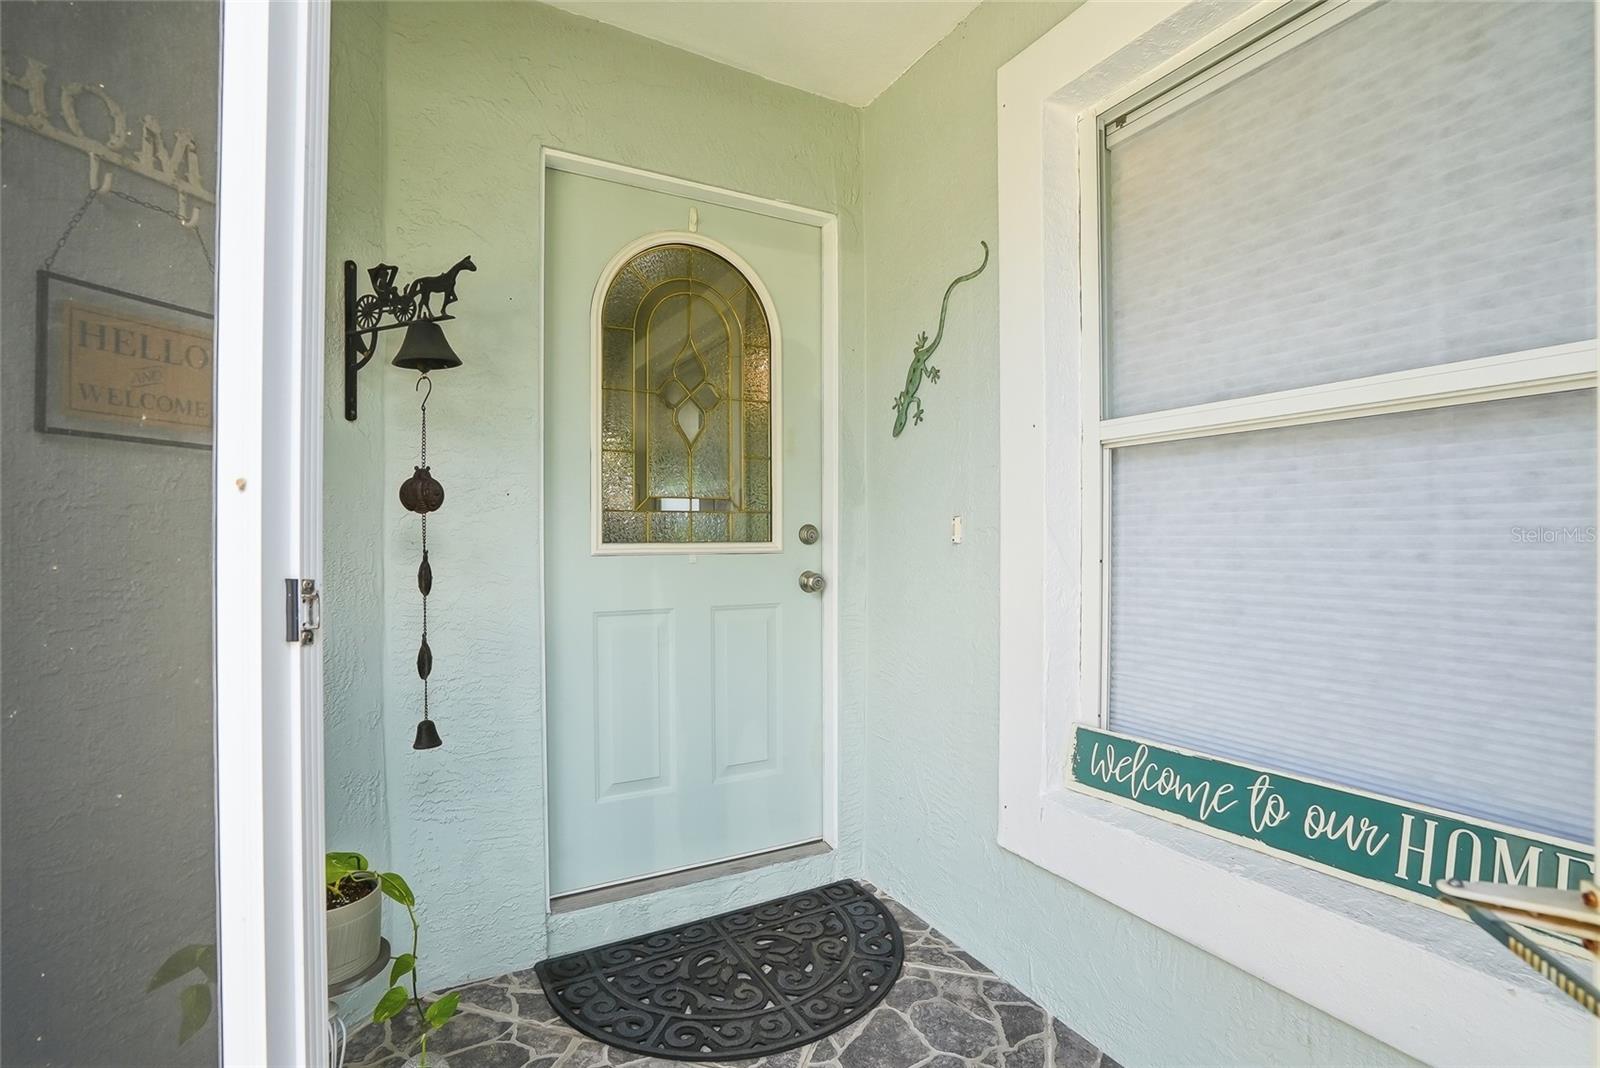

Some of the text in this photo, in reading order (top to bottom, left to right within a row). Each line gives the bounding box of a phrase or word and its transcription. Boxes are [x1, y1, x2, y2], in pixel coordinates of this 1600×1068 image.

[79, 319, 209, 369] HELLO
[79, 382, 208, 418] WELCOME
[1247, 775, 1290, 833] to
[1303, 805, 1390, 856] our
